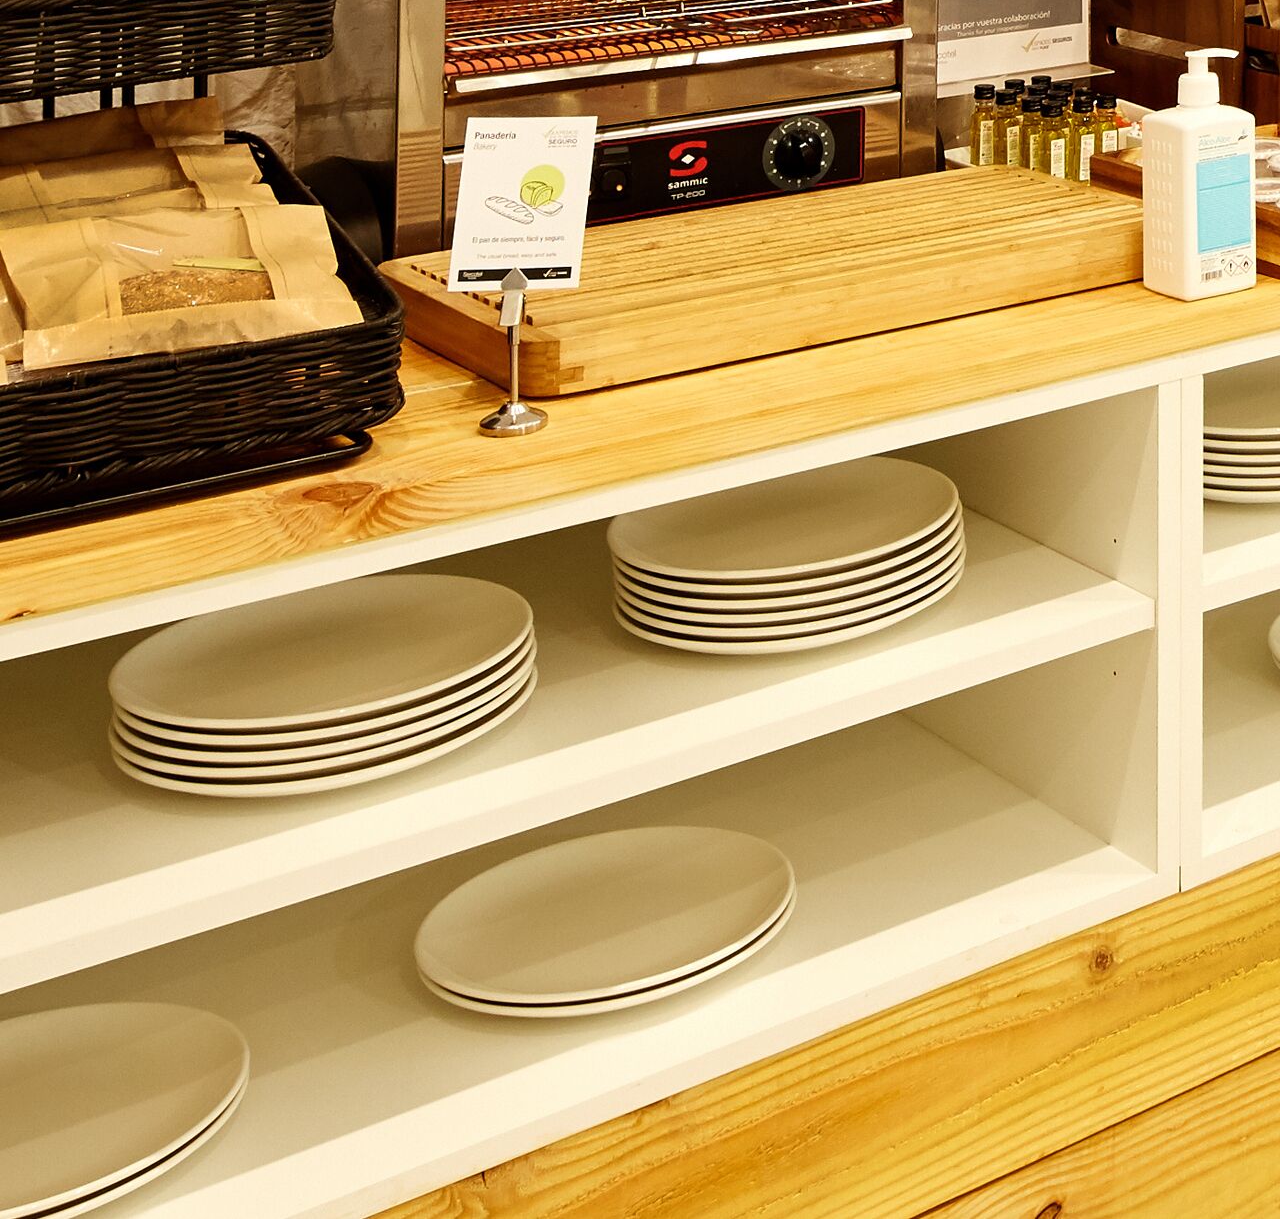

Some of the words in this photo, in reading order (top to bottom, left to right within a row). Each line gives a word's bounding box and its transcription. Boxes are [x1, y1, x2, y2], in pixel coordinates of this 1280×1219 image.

[963, 20, 976, 30] por
[976, 17, 1003, 28] vuestra
[1003, 10, 1051, 24] colaboración!
[474, 131, 517, 140] Panadería
[667, 176, 708, 190] sammic
